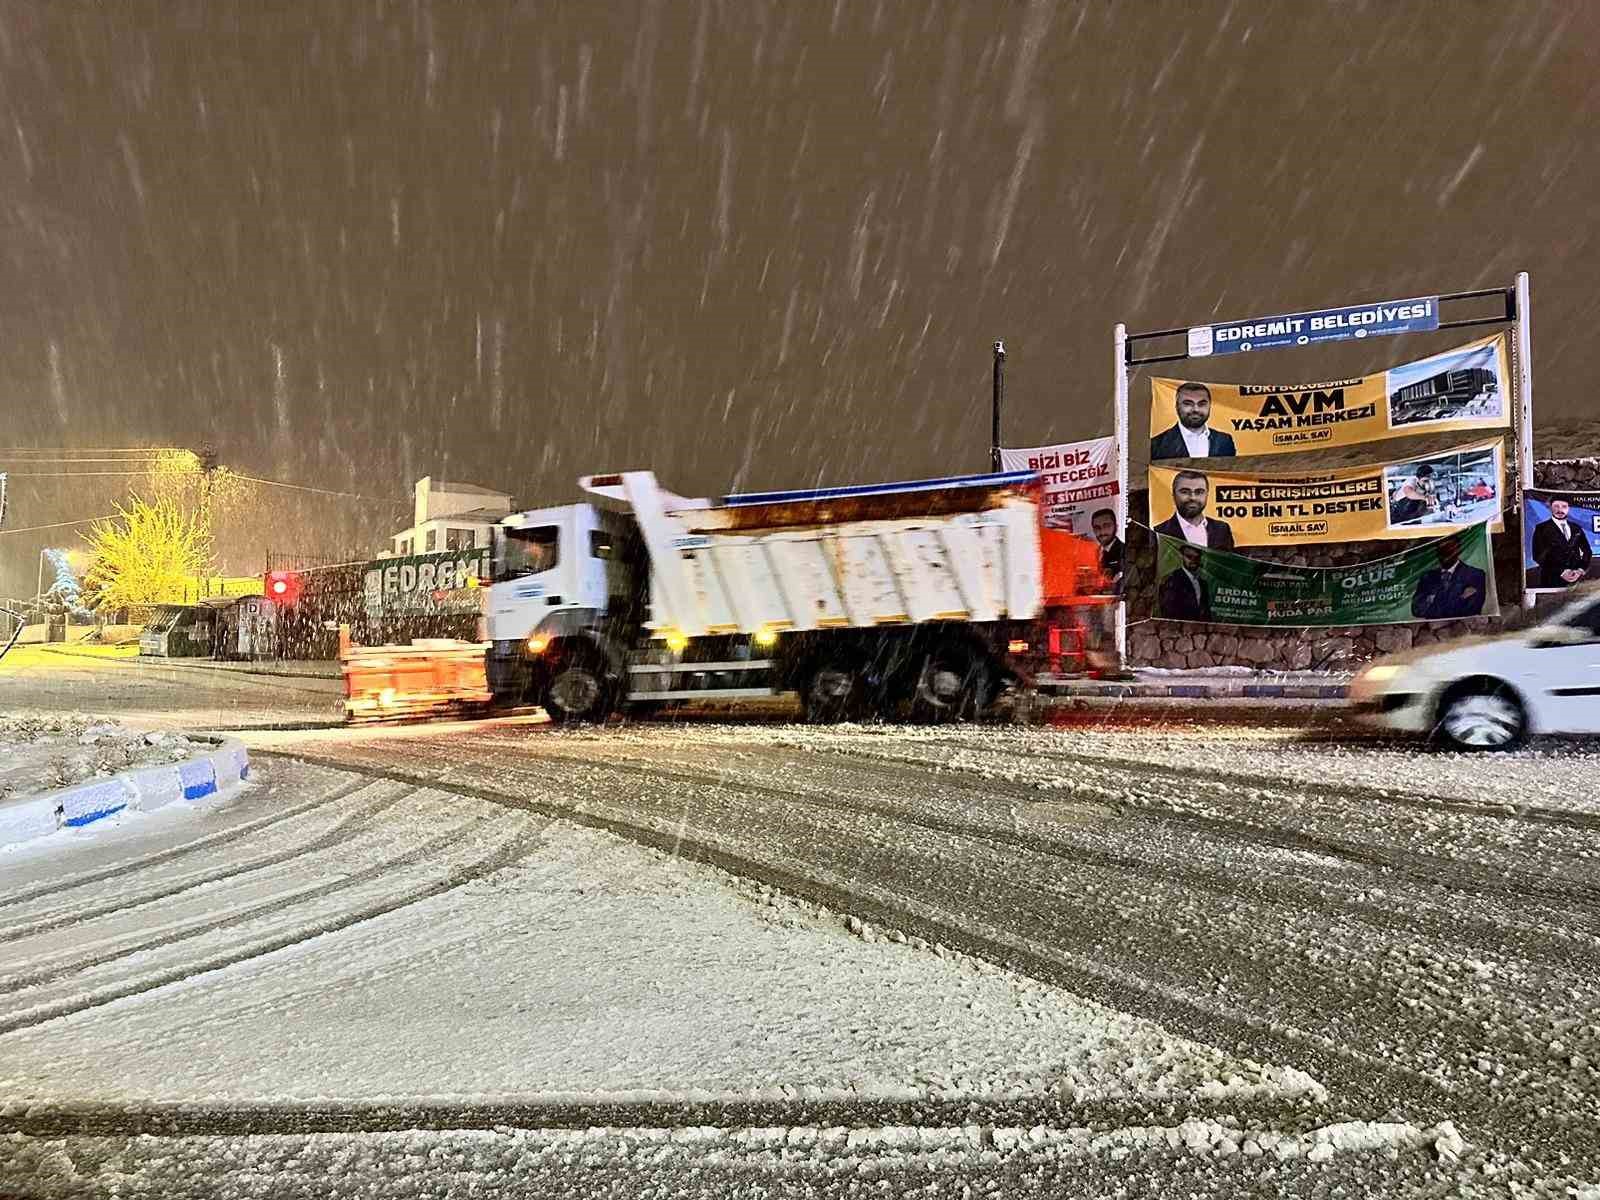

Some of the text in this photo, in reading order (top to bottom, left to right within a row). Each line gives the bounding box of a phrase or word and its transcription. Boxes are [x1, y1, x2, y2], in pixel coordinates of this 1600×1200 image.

[1216, 318, 1304, 342] EDREMİT
[1310, 300, 1432, 330] BELEDİYESİ
[1259, 389, 1345, 417] AVM
[1231, 403, 1376, 432] YAŞAM MERKEZİ
[1275, 432, 1308, 443] İSMAİL
[1311, 430, 1330, 440] SAY
[1028, 449, 1090, 470] BİZİ BİZ
[1042, 463, 1109, 486] ETECEĞİZ
[1220, 480, 1378, 500] YENİ GİRİŞİMCİLERE
[1216, 497, 1383, 518] 100 BİN TL DESTEK
[1271, 521, 1326, 533] İSMAİL SAY
[384, 550, 490, 592] EDREMİ
[1341, 568, 1396, 588] OLUR
